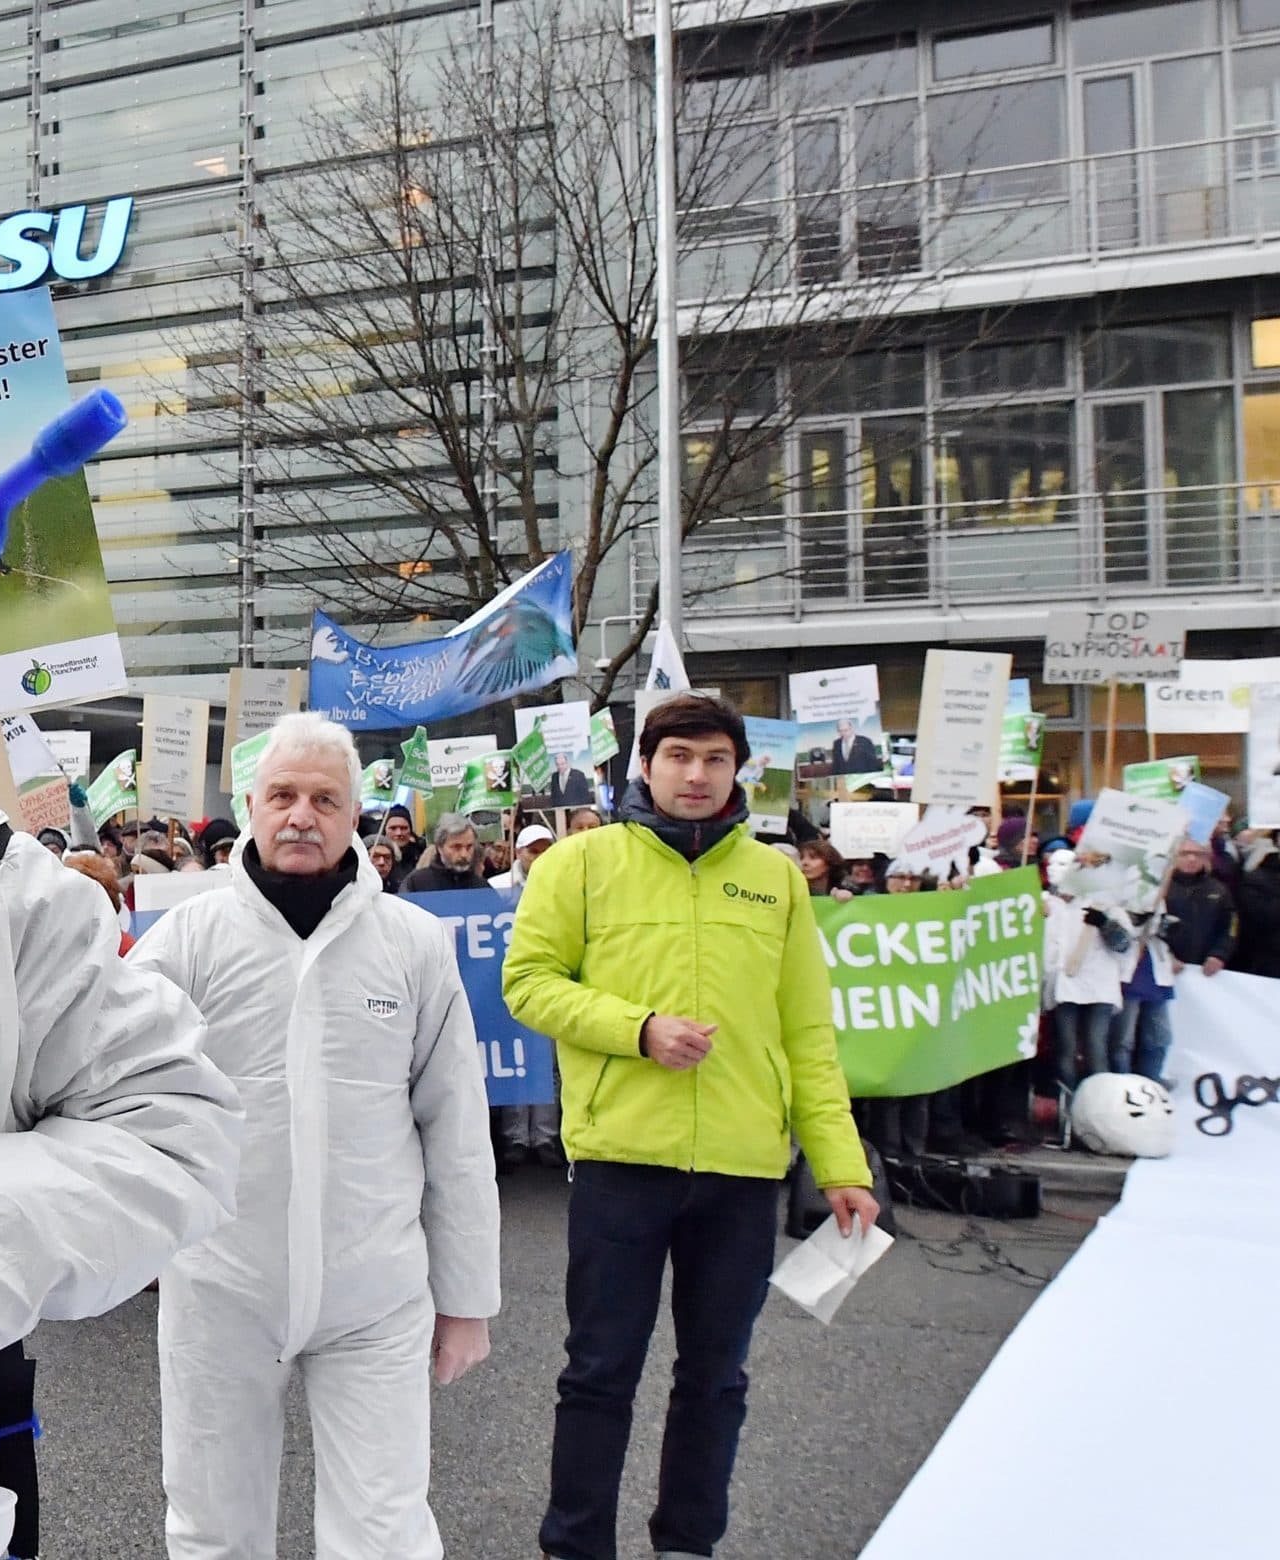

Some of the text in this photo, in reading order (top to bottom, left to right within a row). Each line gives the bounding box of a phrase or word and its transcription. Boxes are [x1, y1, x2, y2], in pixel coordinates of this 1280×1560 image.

[1086, 611, 1150, 631] TOD
[1157, 685, 1224, 702] Green
[59, 756, 80, 764] osat
[740, 889, 778, 905] BUND
[952, 951, 1040, 1022] ANKE!
